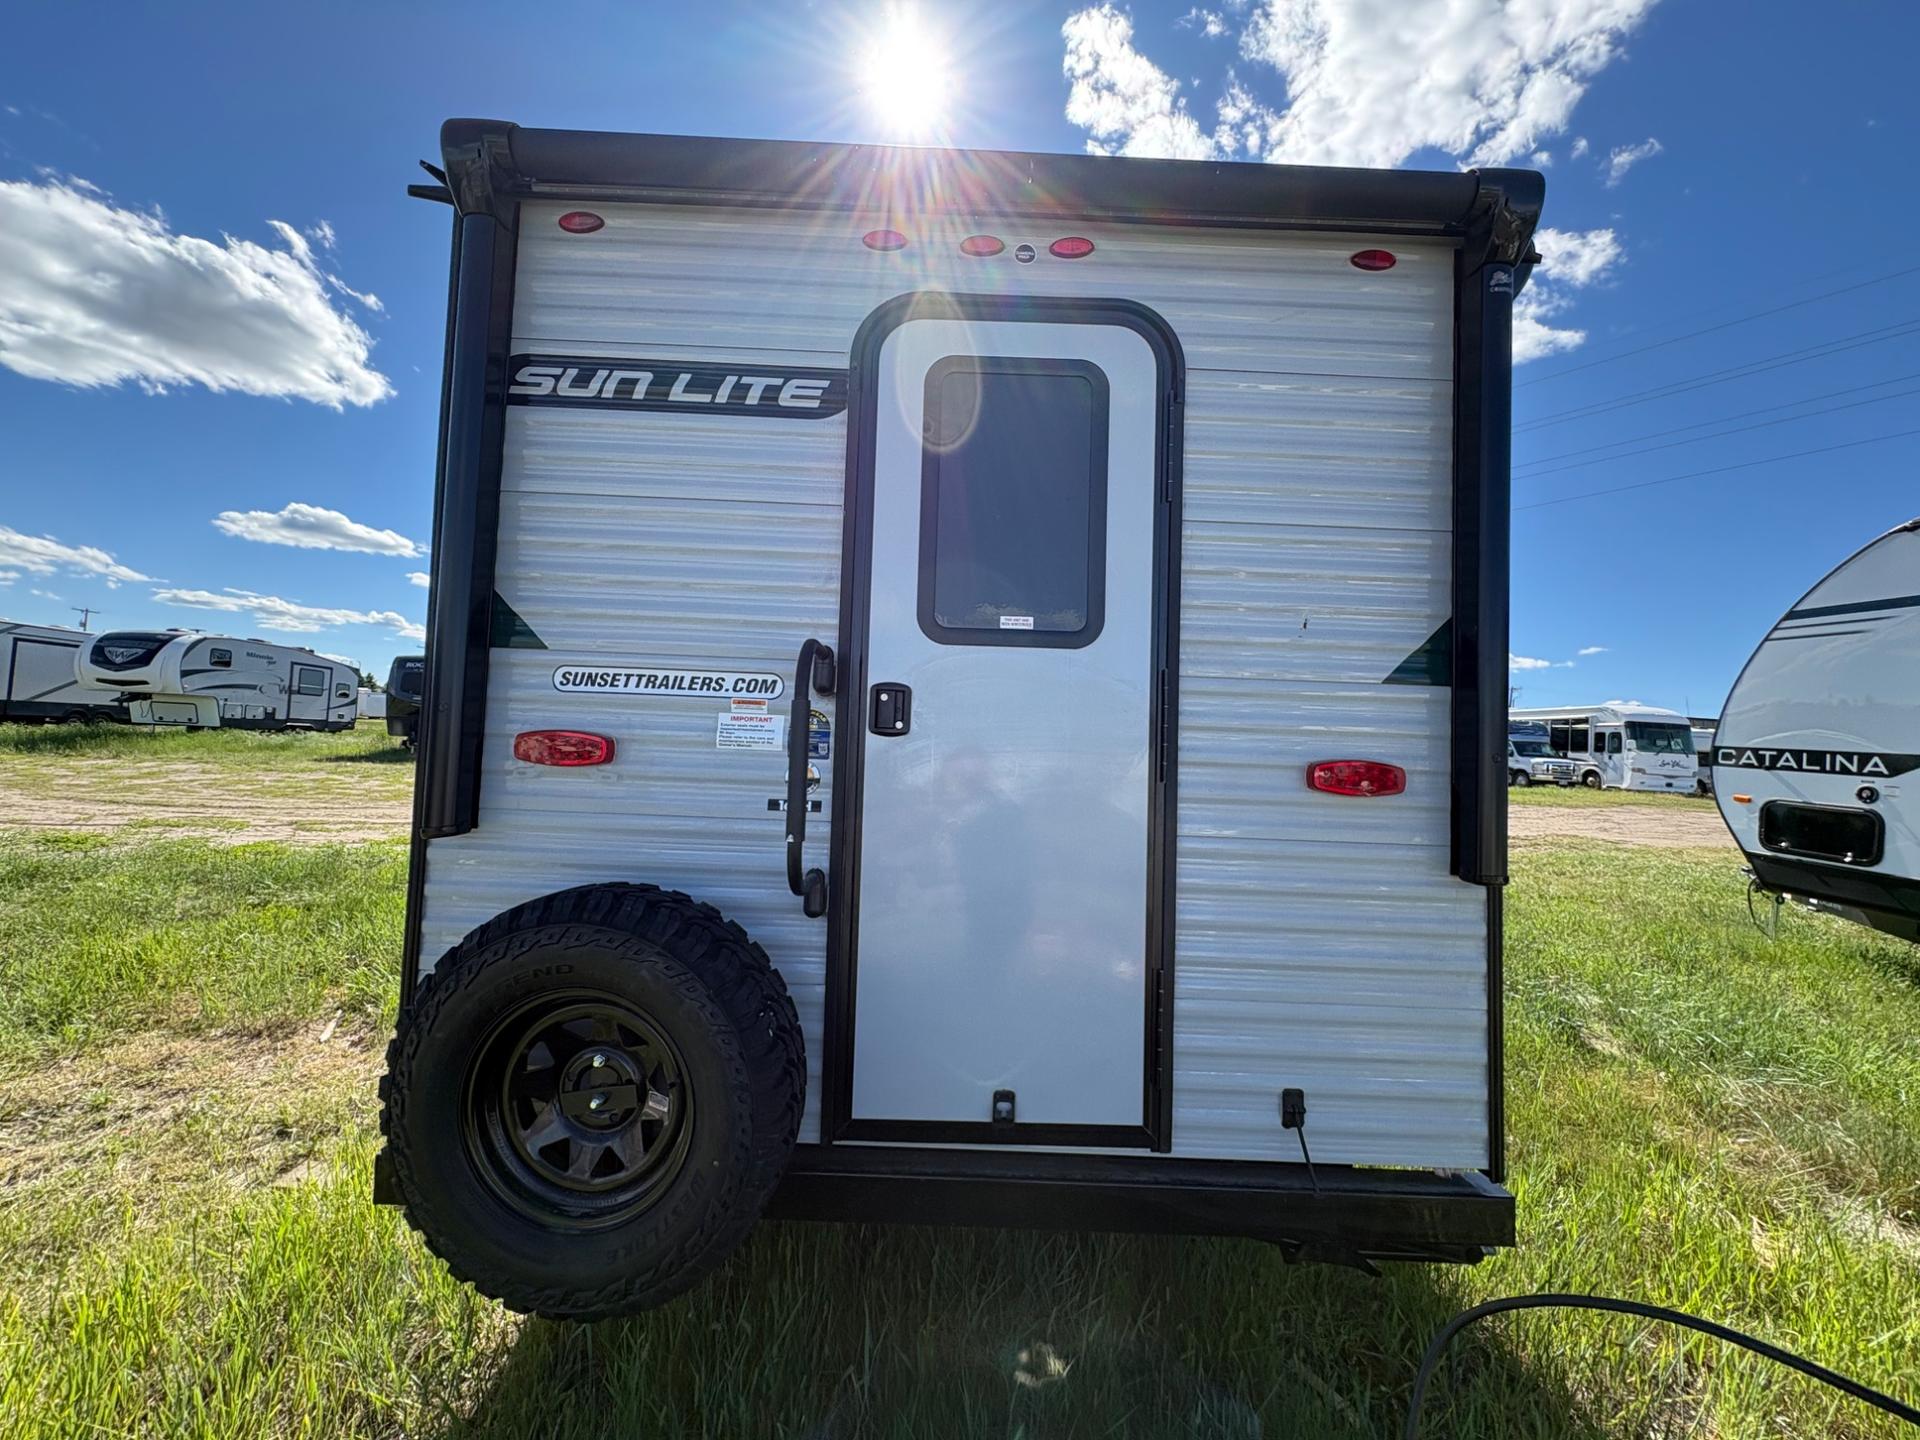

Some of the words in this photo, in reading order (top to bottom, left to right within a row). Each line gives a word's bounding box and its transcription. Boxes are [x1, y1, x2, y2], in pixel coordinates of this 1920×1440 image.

[508, 366, 654, 400] SUN
[667, 373, 831, 409] LITE
[559, 670, 778, 695] SUNSETTRAILERS.COM
[1717, 749, 1889, 776] CATALINA
